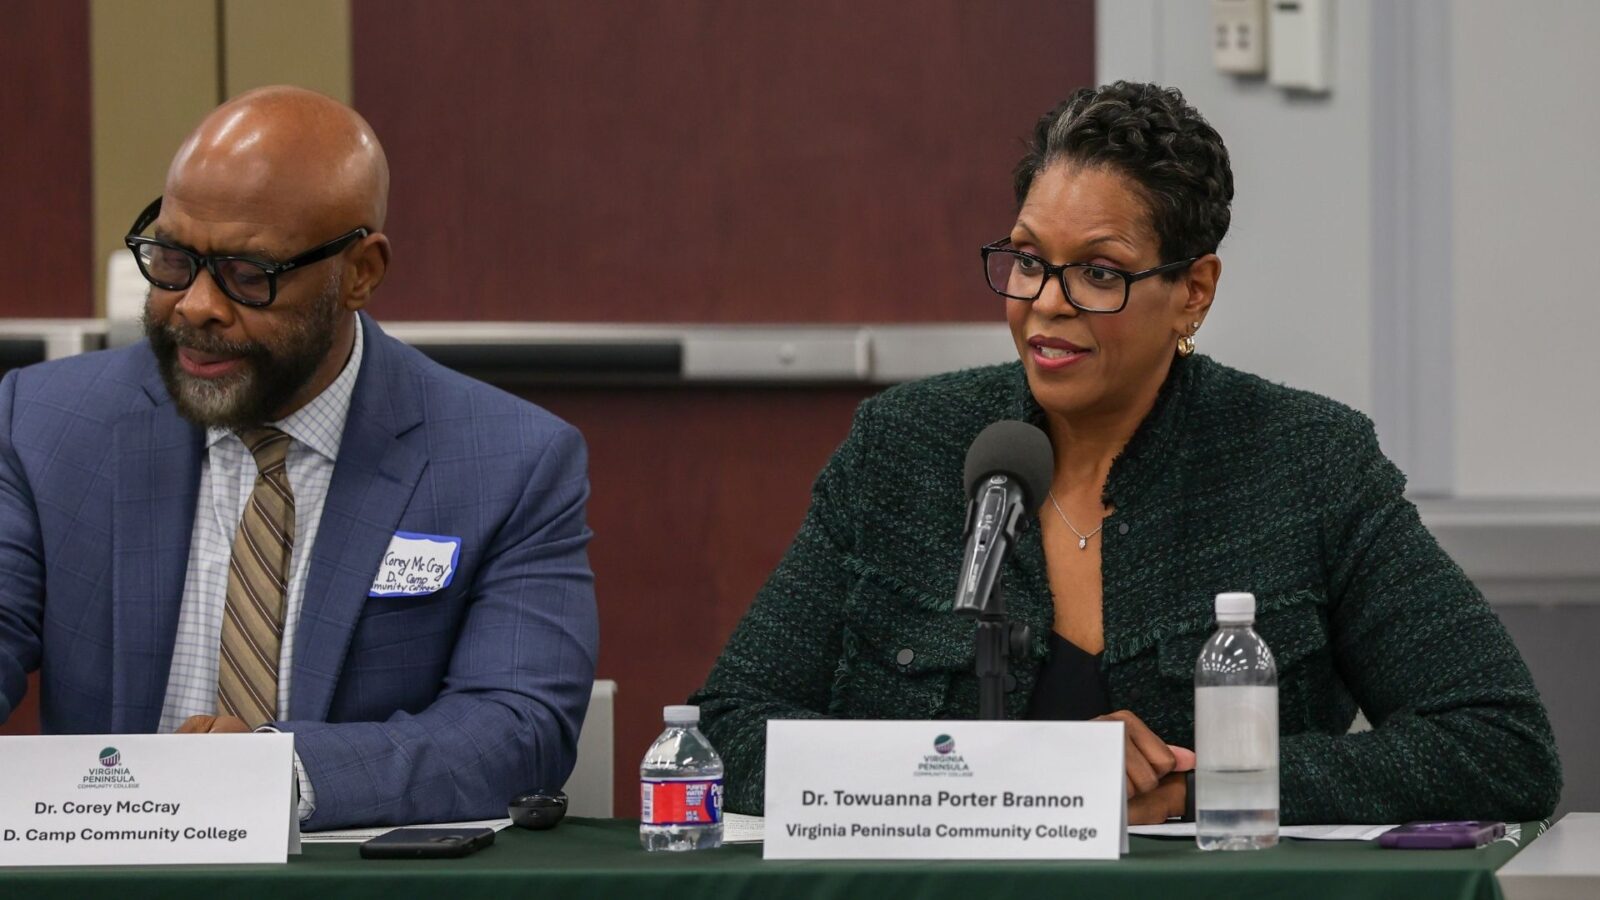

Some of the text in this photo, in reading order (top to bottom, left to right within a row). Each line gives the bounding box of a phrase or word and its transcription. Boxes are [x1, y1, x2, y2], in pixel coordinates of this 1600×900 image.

[385, 551, 410, 576] Corey
[374, 582, 407, 593] munity
[923, 755, 965, 763] VIRGINIA
[88, 767, 131, 775] VIRGINIA
[918, 763, 970, 771] PENINSULA
[82, 775, 136, 783] PENINSULA
[802, 790, 1084, 808] Dr. Towuanna Porter Brannon
[34, 800, 181, 816] Dr. Corey McCray
[3, 827, 248, 843] D. Camp Community College
[786, 823, 1098, 840] Virginia Peninsula Community College
